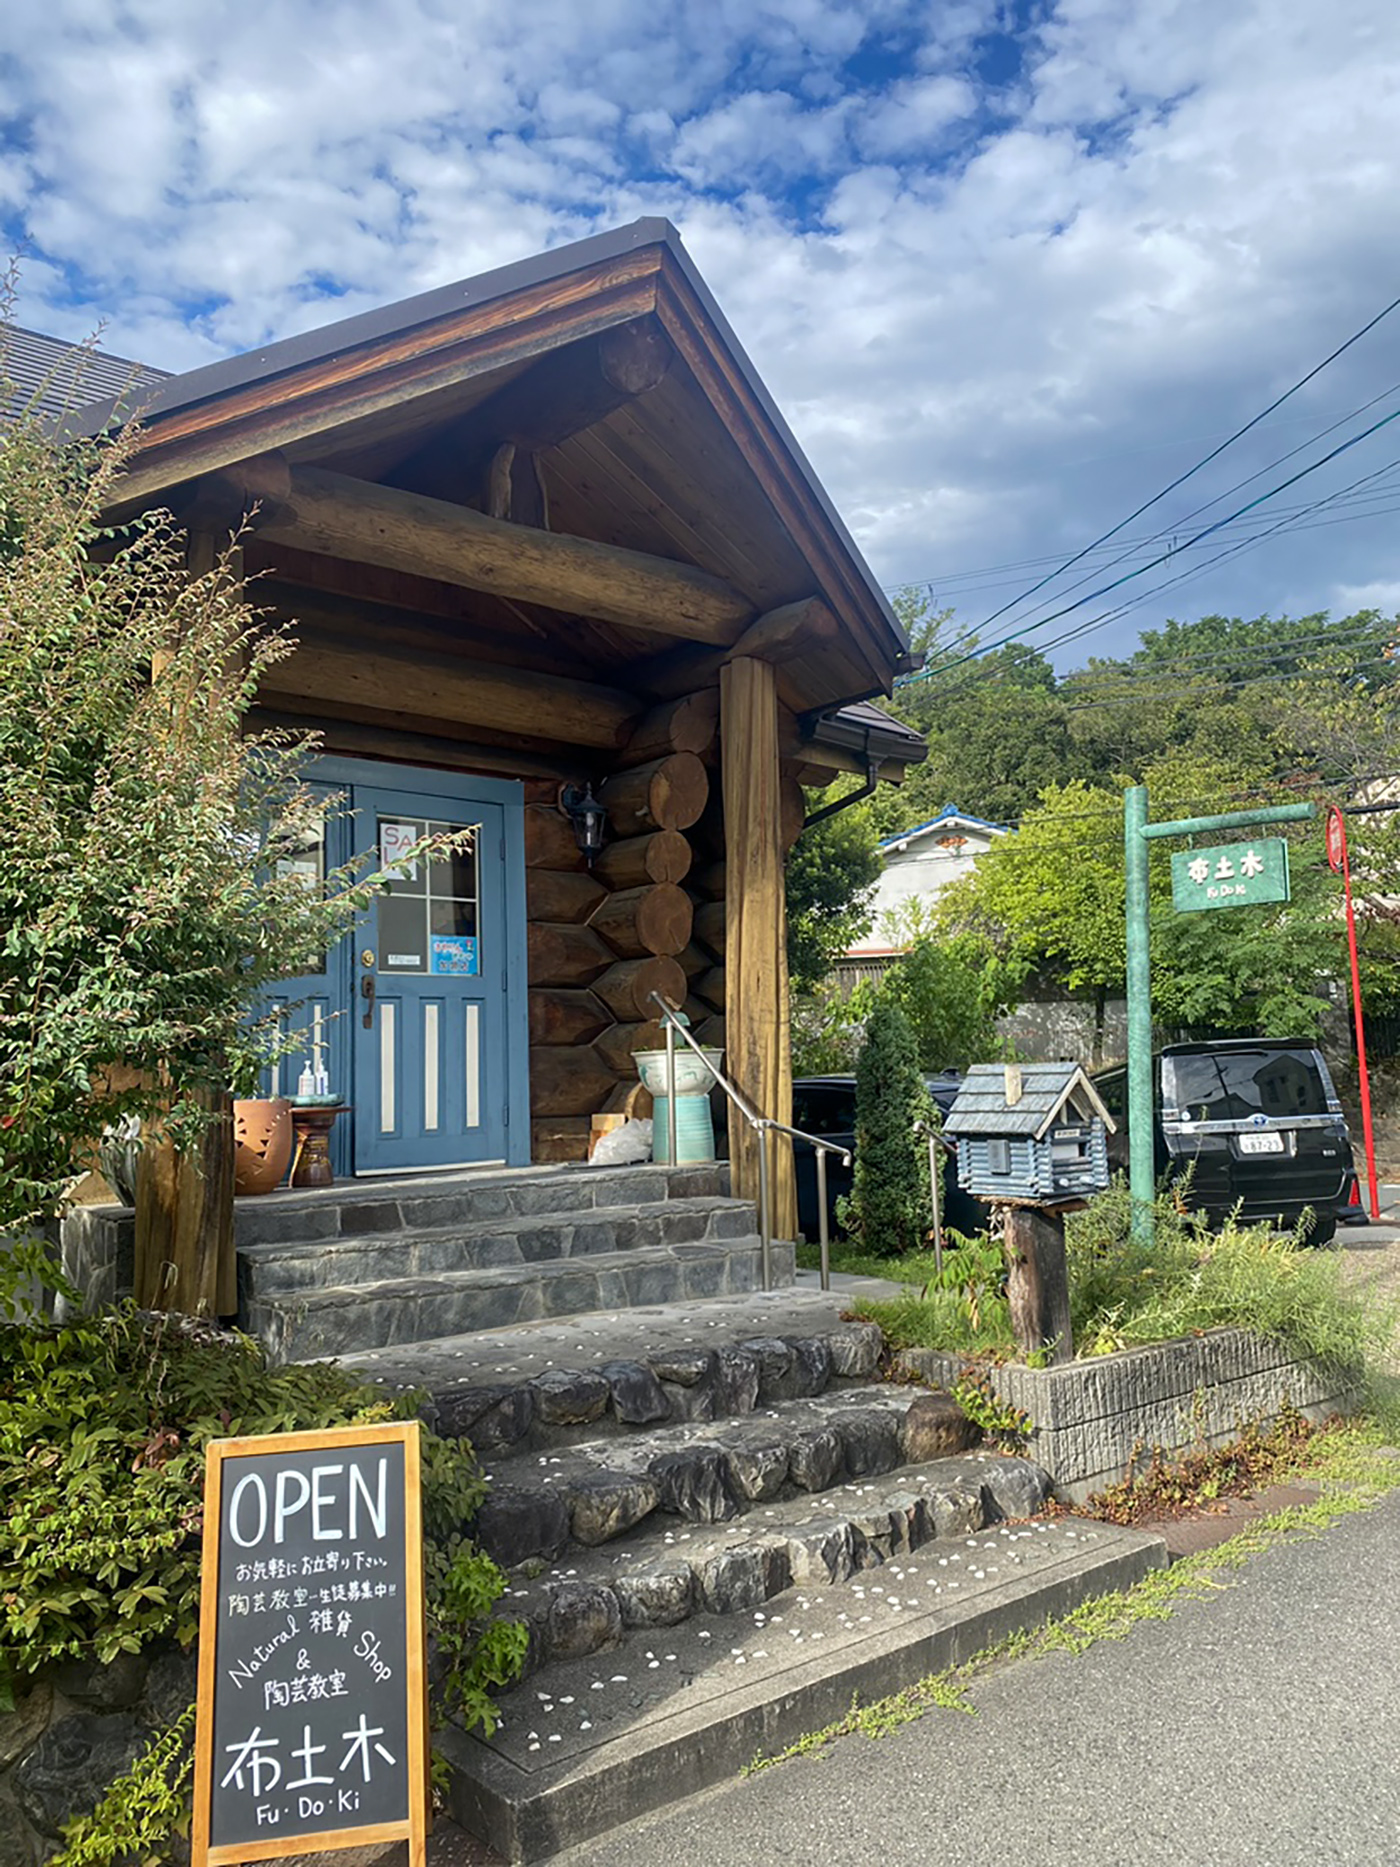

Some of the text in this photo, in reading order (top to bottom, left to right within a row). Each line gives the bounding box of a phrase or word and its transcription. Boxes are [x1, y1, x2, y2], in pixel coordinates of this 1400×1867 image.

[1187, 849, 1264, 885] 布土木
[229, 1458, 388, 1548] OPEN
[228, 1607, 392, 1690] Natural 雑貨 Shop
[296, 1648, 311, 1671] &
[264, 1669, 349, 1710] 陶芸教室
[220, 1713, 396, 1797] 布土木
